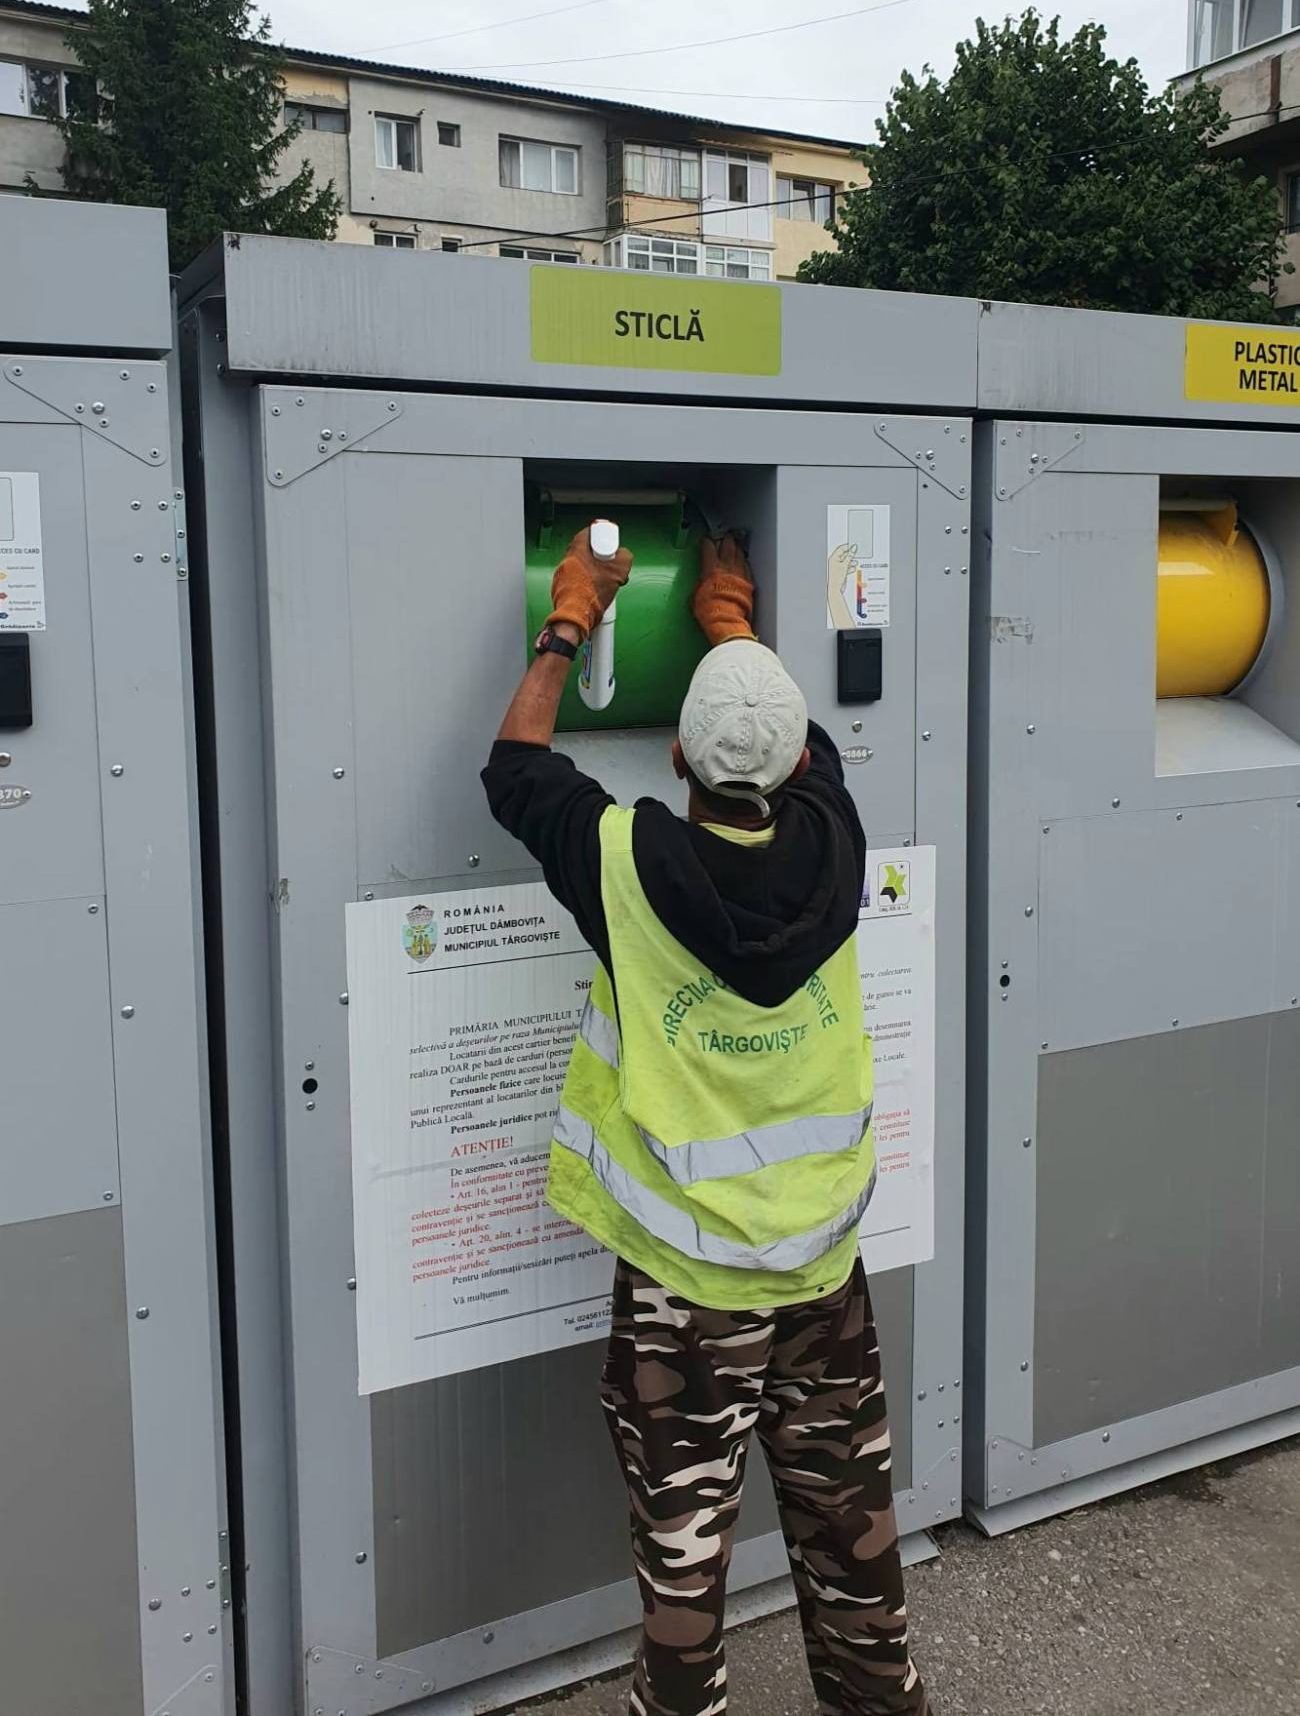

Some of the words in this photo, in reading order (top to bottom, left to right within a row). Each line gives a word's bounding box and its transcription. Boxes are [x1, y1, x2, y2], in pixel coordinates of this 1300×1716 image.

[614, 309, 705, 342] STICLĂ
[1239, 369, 1298, 392] METAL
[444, 922, 488, 936] JUDEȚUL
[490, 916, 545, 930] DÂMBOVIȚA
[444, 938, 499, 952] MUNICIPIUL
[502, 931, 560, 946] TÂRGOVIȘTE
[450, 1022, 499, 1036] PRIMĂRIA
[504, 1009, 571, 1028] MUNICIPIULUI
[532, 1021, 582, 1037] Municipiulu
[489, 1046, 501, 1055] din
[503, 1043, 524, 1053] acest
[553, 1034, 577, 1045] benefi
[409, 1069, 438, 1080] realiza
[440, 1063, 470, 1075] DOAR
[472, 1062, 482, 1072] pe
[484, 1058, 502, 1068] bază
[504, 1056, 514, 1064] de
[516, 1053, 544, 1063] carduri
[449, 1073, 489, 1085] Cardurile
[491, 1069, 516, 1080] pentru
[518, 1063, 547, 1074] accesul
[450, 1083, 497, 1098] Persoanele
[499, 1079, 522, 1089] fizice
[524, 1077, 540, 1085] care
[543, 1073, 568, 1082] locuie
[432, 1099, 483, 1114] reprezentant
[486, 1095, 494, 1103] al
[497, 1089, 538, 1102] locatarilor
[540, 1087, 553, 1095] din
[411, 1117, 442, 1129] Publică
[450, 1119, 498, 1134] Persoanele
[499, 1113, 533, 1127] juridice
[534, 1110, 547, 1121] pot
[450, 1136, 513, 1158] ATENȚIE!
[450, 1168, 463, 1177] De
[509, 1156, 519, 1165] vă
[520, 1153, 551, 1163] aducem
[515, 1169, 525, 1177] cu
[526, 1165, 550, 1178] preve
[452, 1272, 479, 1285] Pentru
[453, 1295, 466, 1305] Vă
